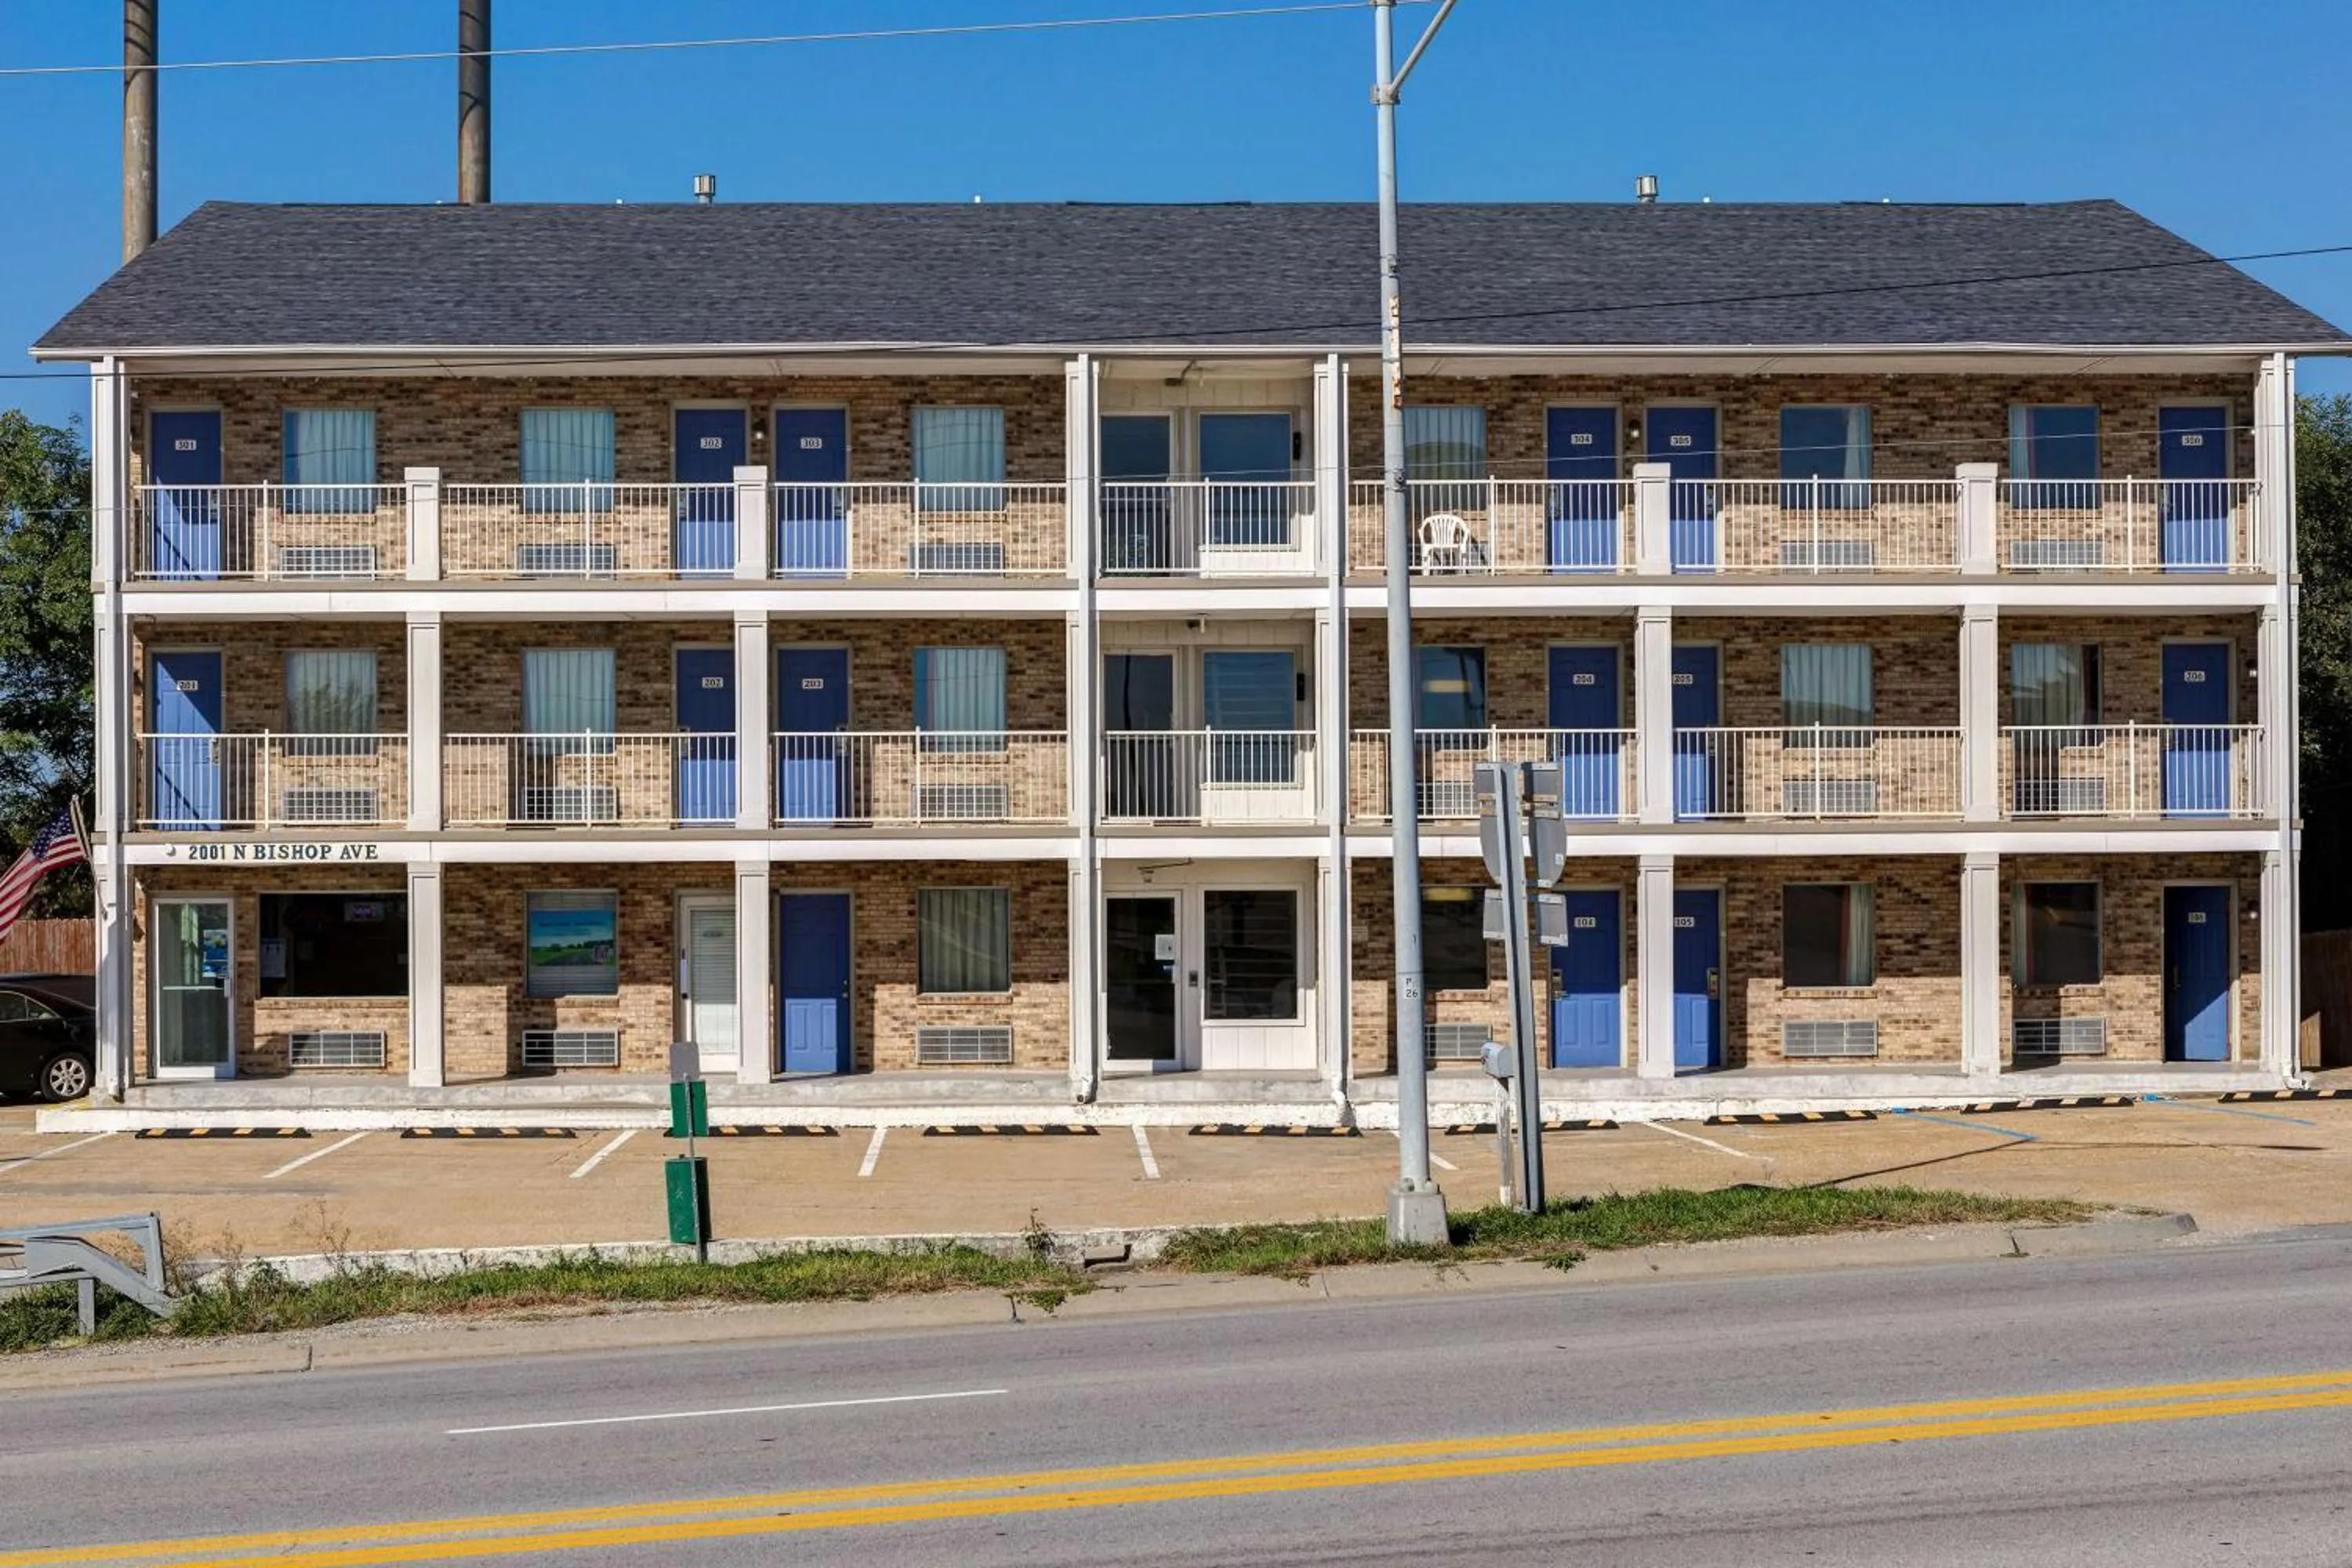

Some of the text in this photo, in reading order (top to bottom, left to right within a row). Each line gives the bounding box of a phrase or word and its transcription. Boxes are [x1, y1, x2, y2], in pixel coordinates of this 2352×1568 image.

[702, 438, 719, 447] 302
[803, 438, 819, 447] 303
[189, 844, 378, 860] 2001 N BISHOP AVE
[1406, 989, 1418, 998] 26
